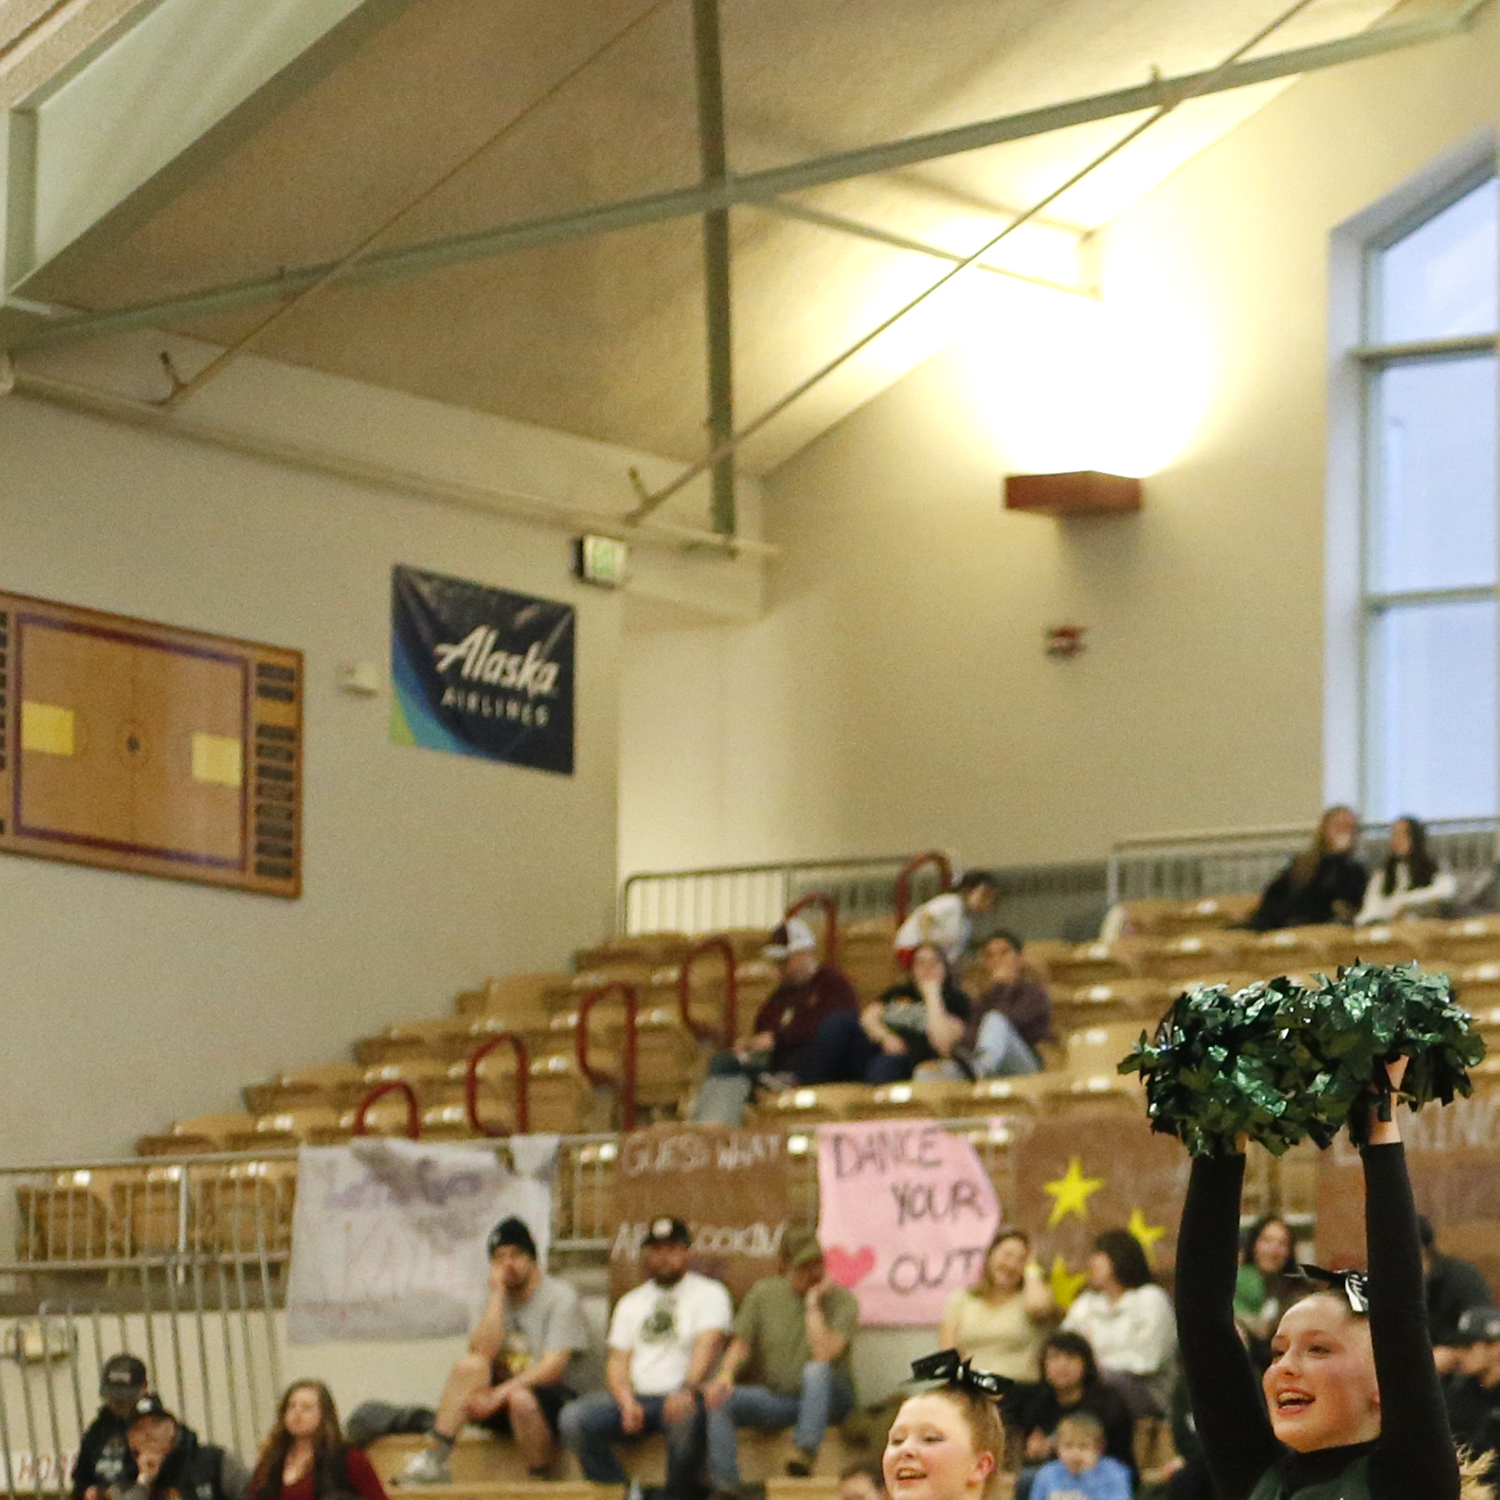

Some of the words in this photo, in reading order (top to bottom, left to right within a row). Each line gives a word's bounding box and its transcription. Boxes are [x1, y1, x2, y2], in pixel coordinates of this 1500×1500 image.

[433, 624, 559, 699] Alaska
[440, 686, 549, 727] AIRLINES
[833, 1126, 943, 1178] DANCE
[891, 1179, 986, 1226] YOUR
[888, 1247, 988, 1296] OUT
